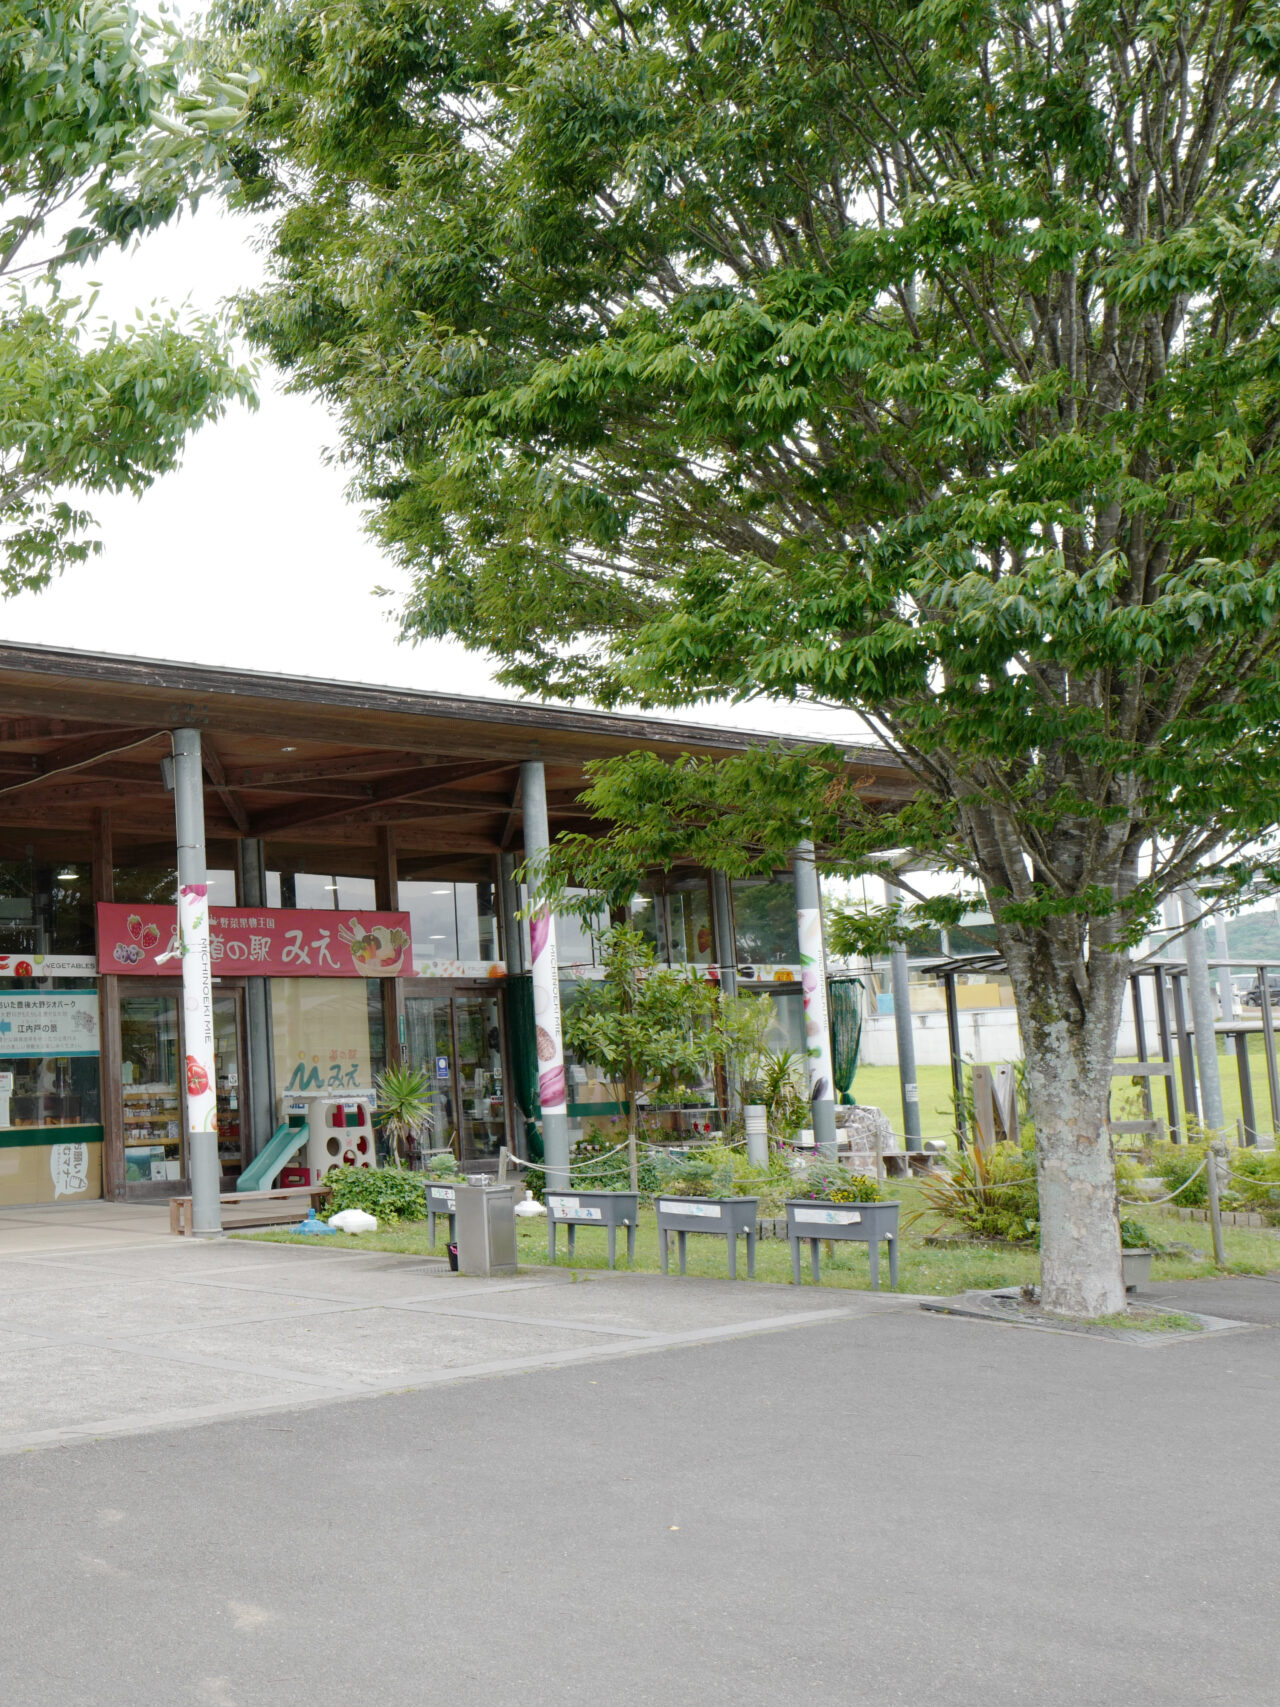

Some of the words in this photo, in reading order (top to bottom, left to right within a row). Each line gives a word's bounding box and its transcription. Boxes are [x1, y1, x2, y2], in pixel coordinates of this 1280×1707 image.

[209, 932, 273, 963] 道の駅
[281, 928, 341, 969] みえ
[45, 962, 96, 970] VEGETABLES
[200, 937, 211, 1017] MICHINOEKI
[204, 1020, 212, 1045] MIE
[327, 1063, 361, 1088] みえ
